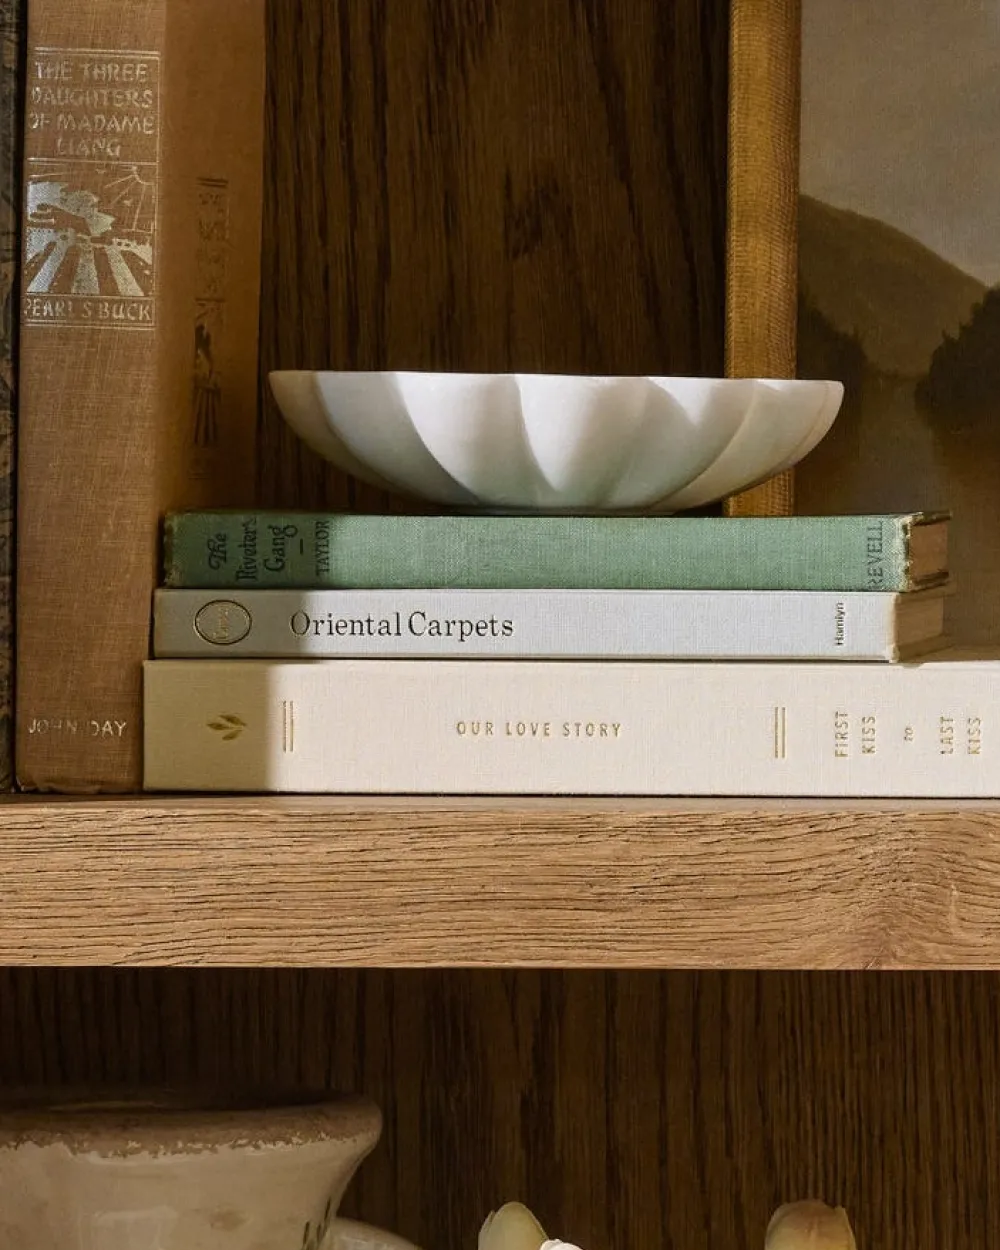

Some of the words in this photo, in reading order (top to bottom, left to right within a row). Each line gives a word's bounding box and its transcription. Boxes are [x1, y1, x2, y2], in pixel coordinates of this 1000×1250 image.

[35, 61, 72, 79] THE
[82, 63, 149, 82] THREE
[58, 114, 154, 134] MADAME
[57, 137, 120, 157] LIANG
[99, 301, 150, 321] BUCK
[207, 533, 227, 570] The
[263, 524, 298, 572] Gang
[315, 520, 330, 577] TAYLOR
[867, 520, 883, 589] REVELL
[290, 611, 402, 637] Oriental
[408, 611, 513, 642] Carpets
[835, 602, 846, 646] Hamlyn
[91, 720, 127, 738] DAY
[456, 720, 494, 736] OUR
[506, 721, 551, 737] LOVE
[562, 722, 621, 738] STORY
[834, 710, 849, 758] FIRST
[861, 716, 876, 754] KISS
[940, 716, 954, 755] LAST
[967, 717, 981, 755] KISS
